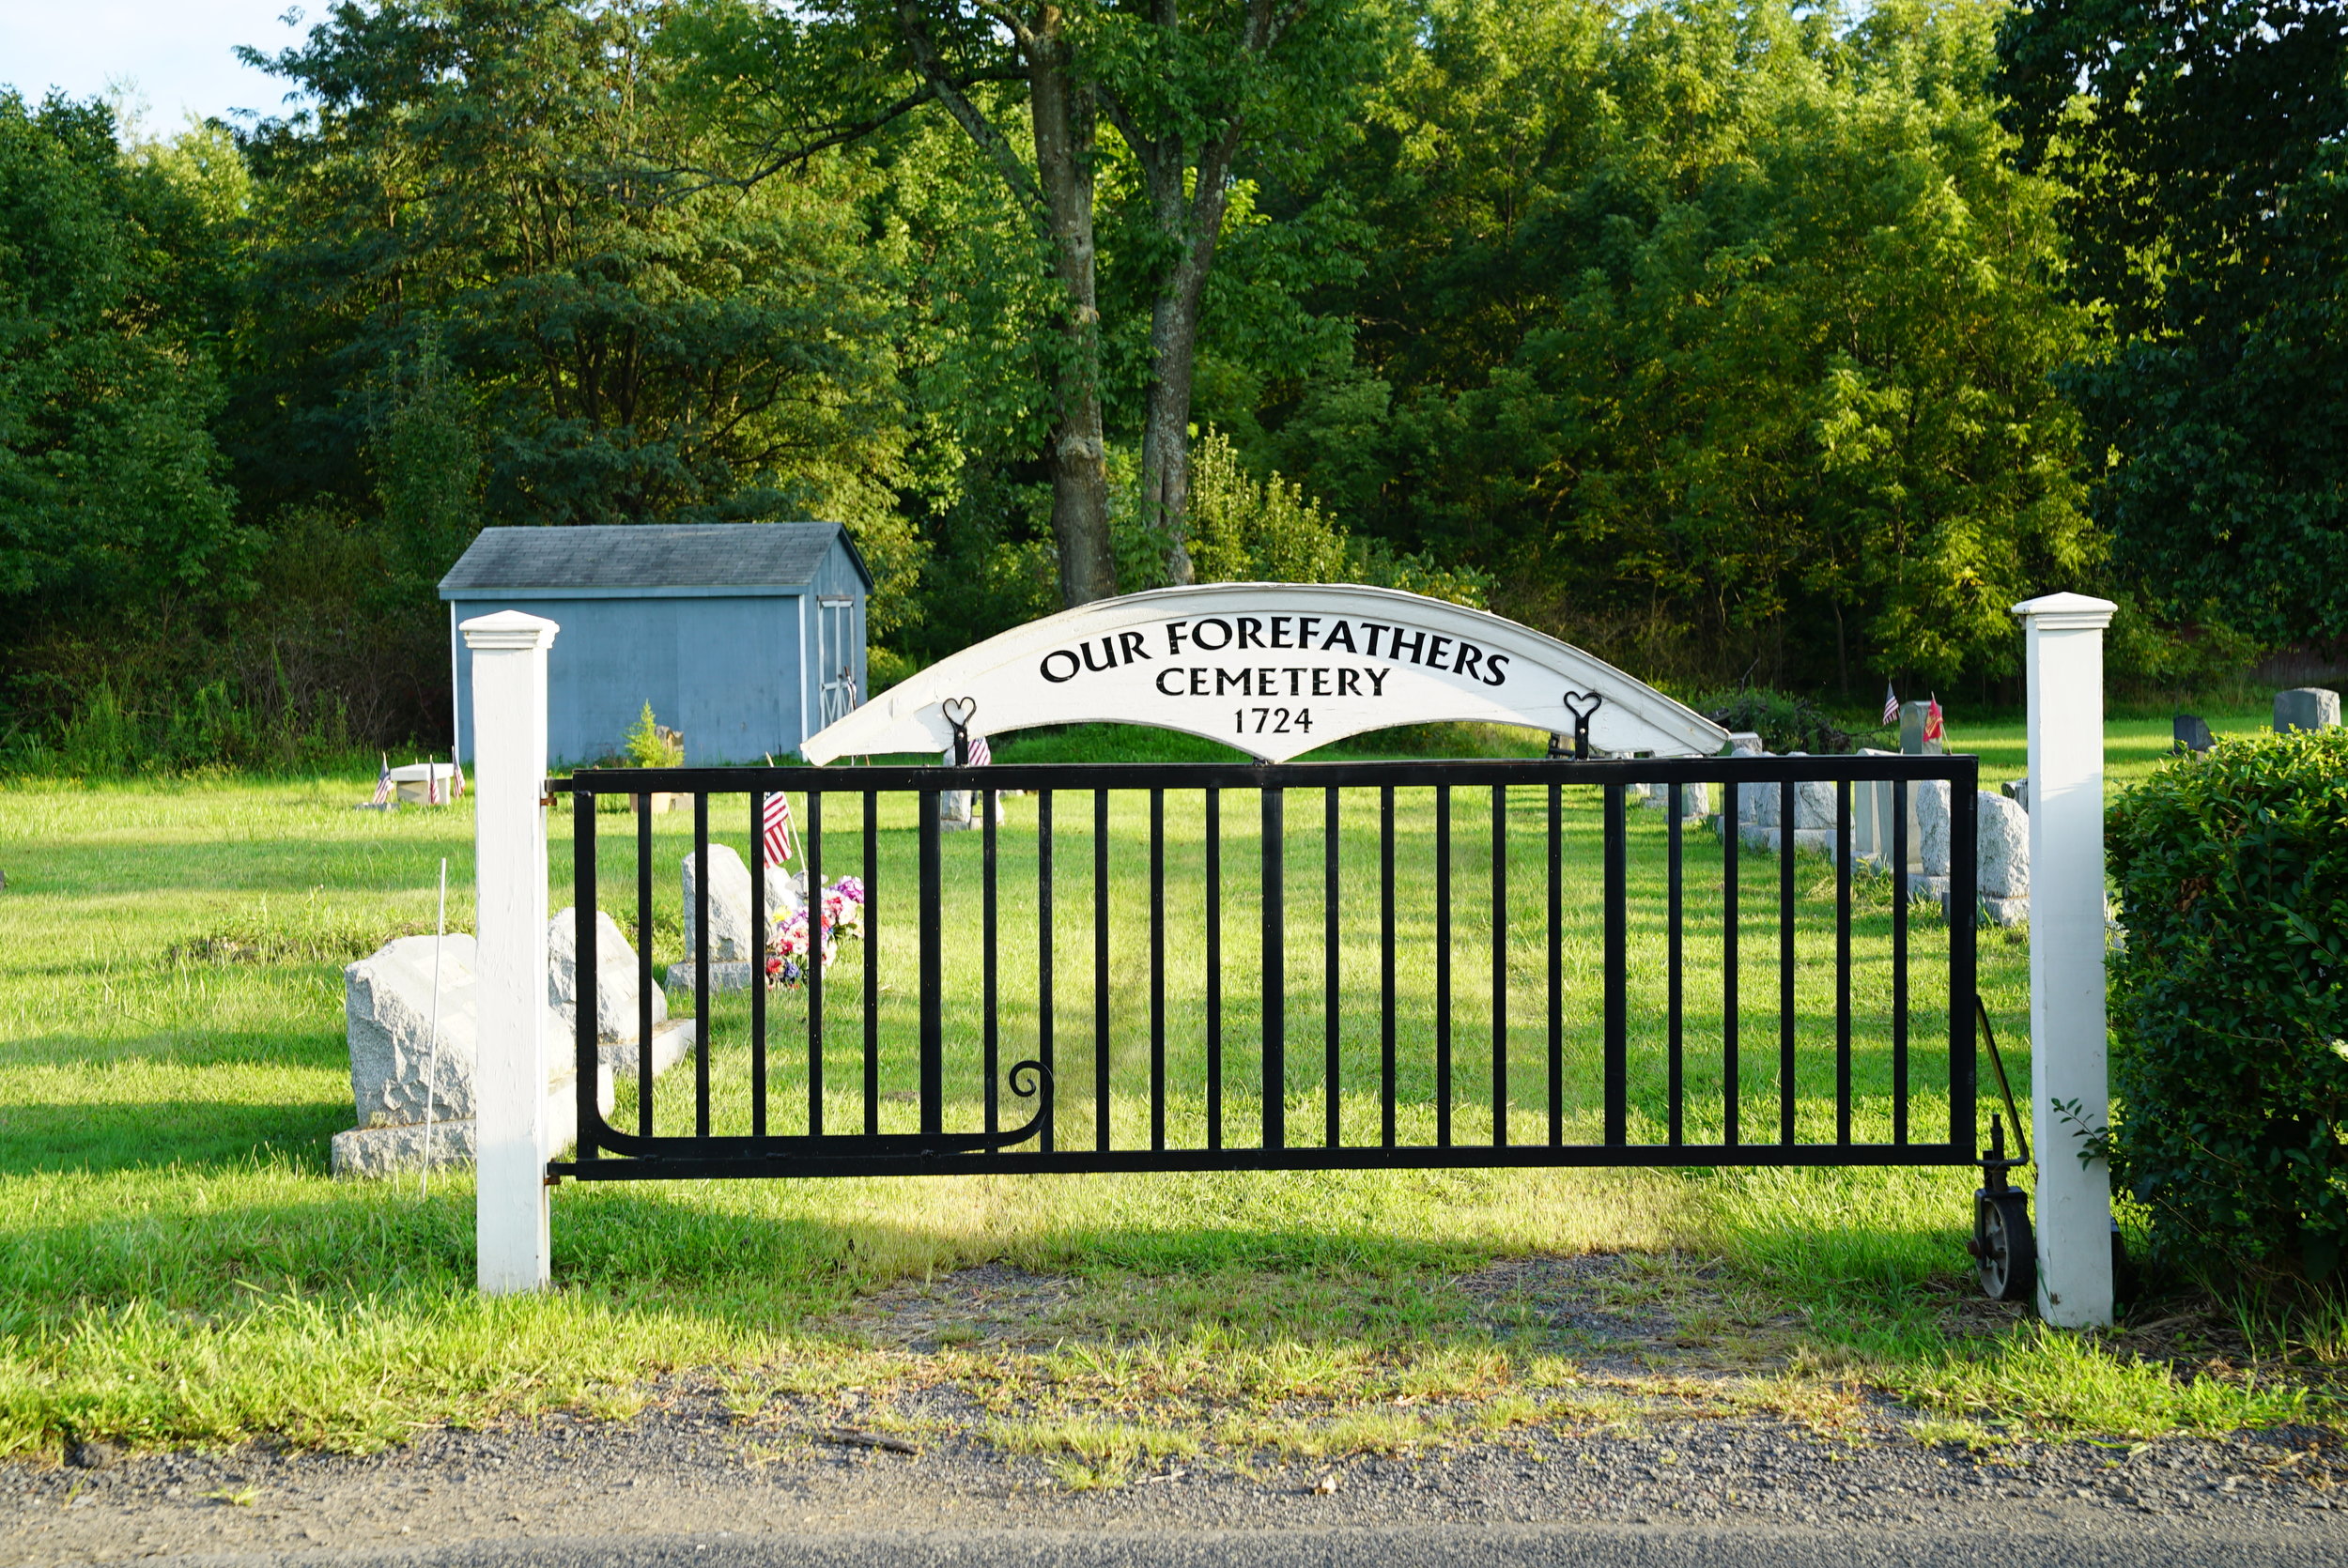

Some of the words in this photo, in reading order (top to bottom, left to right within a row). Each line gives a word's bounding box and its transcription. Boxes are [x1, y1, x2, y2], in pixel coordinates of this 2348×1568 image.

[1041, 631, 1153, 684] OUR
[1166, 616, 1510, 686] FOREFATHERS
[1155, 668, 1391, 697] CEMETERY
[1235, 707, 1314, 733] 1724
